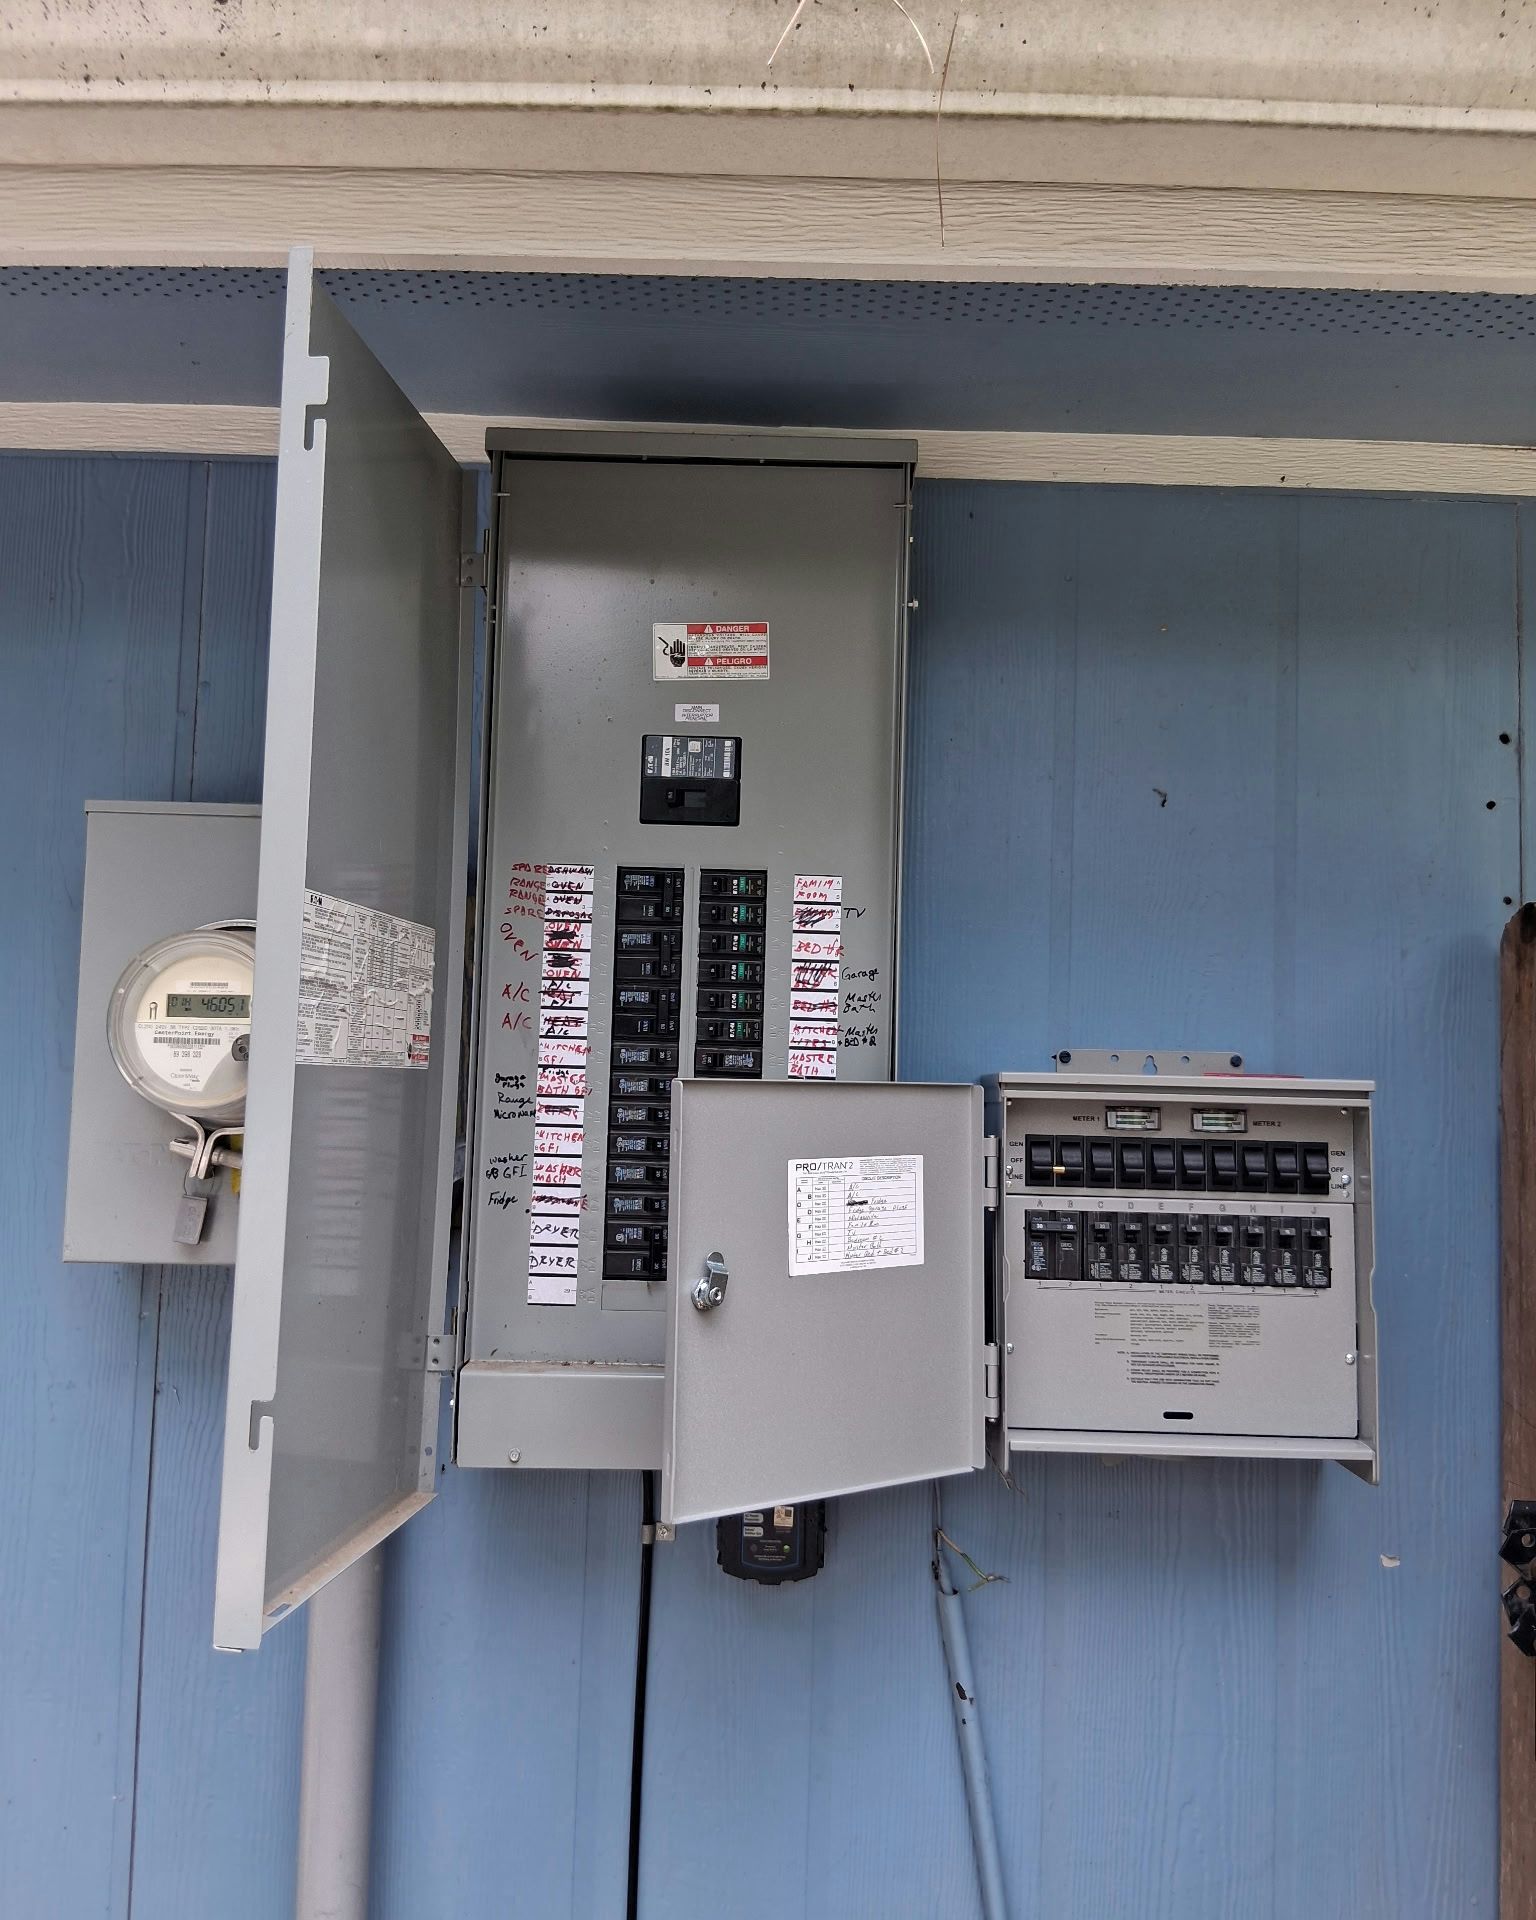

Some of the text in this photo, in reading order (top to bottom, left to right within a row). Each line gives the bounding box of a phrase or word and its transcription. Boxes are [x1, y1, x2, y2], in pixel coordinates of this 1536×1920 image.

[715, 625, 750, 633] DANGER
[716, 658, 752, 666] PELIGRO
[509, 877, 546, 891] RANGE
[551, 881, 584, 891] OVEN
[508, 889, 545, 906] RANGE
[552, 895, 583, 905] OVEN
[503, 905, 545, 920] SPARE
[843, 907, 866, 919] TV
[548, 921, 582, 932] OVEN
[794, 940, 821, 954] BED
[545, 970, 582, 978] OVEN
[841, 966, 879, 981] Garage
[501, 981, 530, 1002] A/C
[501, 1012, 532, 1031] A/C
[544, 1026, 570, 1036] A/C
[789, 1064, 819, 1076] BATH
[537, 1084, 569, 1094] BATH
[539, 1129, 587, 1143] KITCHEN
[539, 1143, 559, 1153] GFI
[502, 1164, 528, 1179] GFI
[1067, 1200, 1074, 1208] B
[1097, 1201, 1104, 1209] C
[1127, 1201, 1134, 1209] D
[1158, 1202, 1165, 1210] E
[1188, 1203, 1194, 1211] F
[1219, 1203, 1226, 1212] G
[1250, 1204, 1257, 1213] H
[1310, 1206, 1317, 1214] J
[532, 1223, 579, 1240] DRYER
[528, 1255, 576, 1269] DRYER
